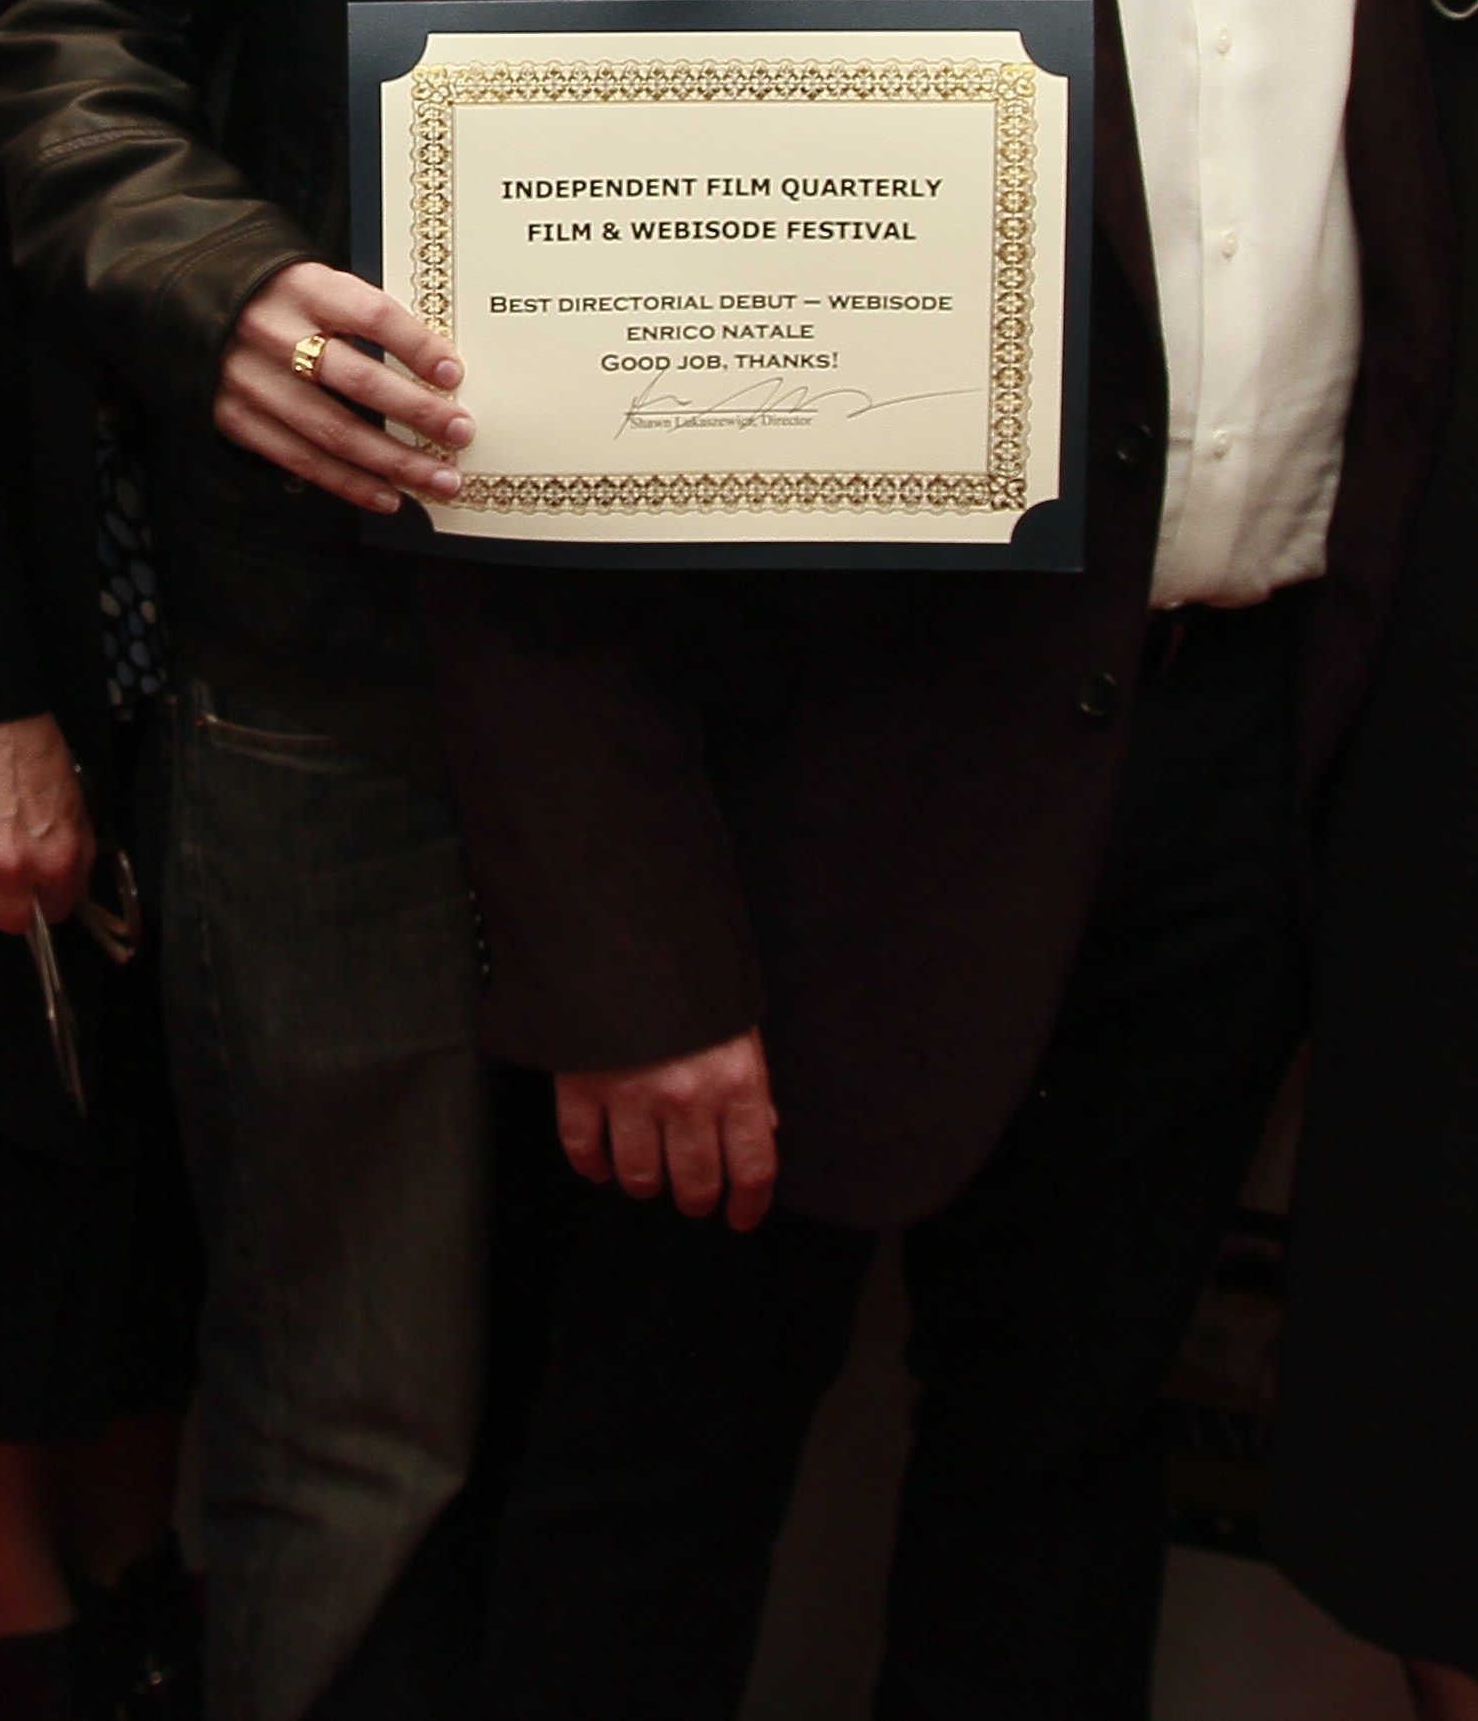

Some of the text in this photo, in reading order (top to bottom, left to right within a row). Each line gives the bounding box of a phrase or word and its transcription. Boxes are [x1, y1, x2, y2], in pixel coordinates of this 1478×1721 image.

[501, 176, 943, 202] INDEPENDENT FILM QUARTERLY
[527, 219, 917, 243] FILM & WEBISODE FESTIVAL
[626, 323, 815, 342] ENRICO NATALE
[761, 414, 813, 426] Director
